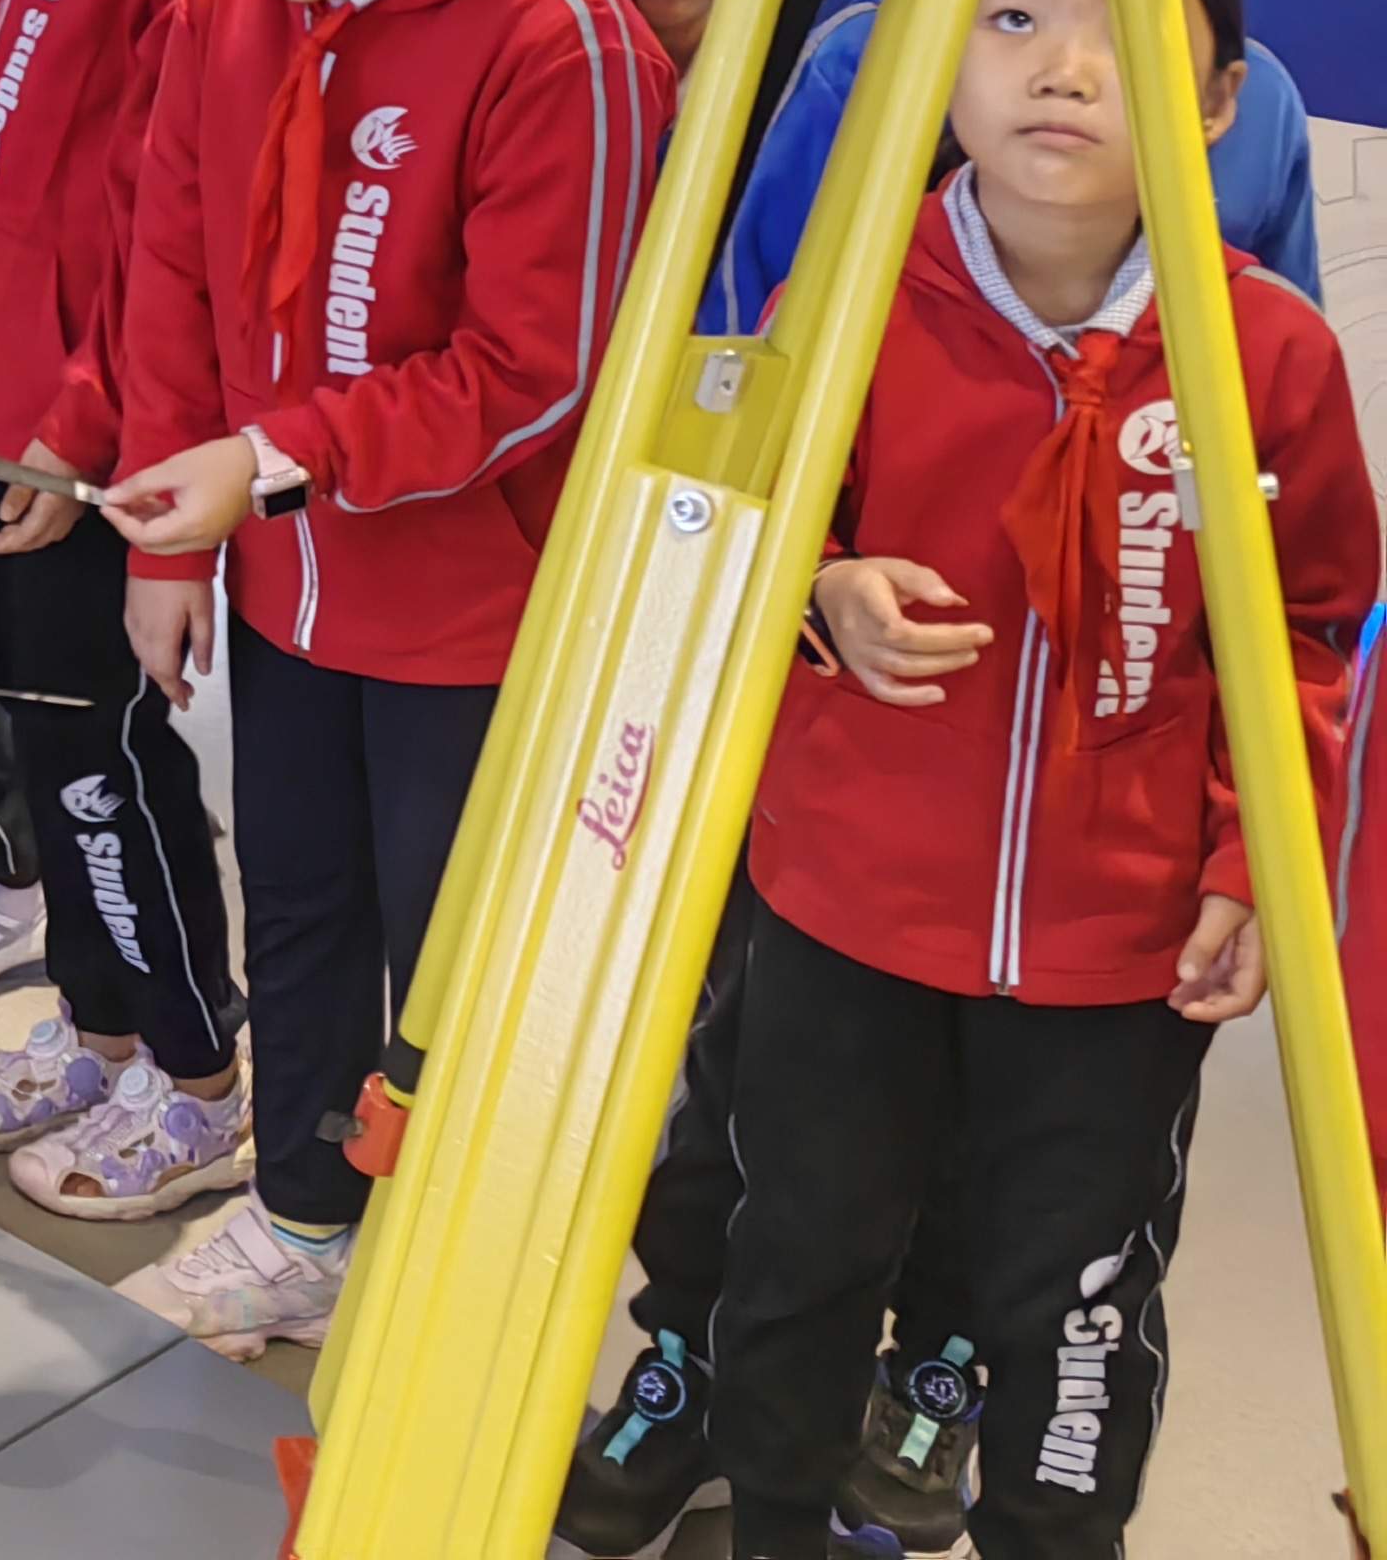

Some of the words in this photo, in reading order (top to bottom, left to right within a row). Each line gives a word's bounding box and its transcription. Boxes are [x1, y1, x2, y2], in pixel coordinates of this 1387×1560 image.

[325, 180, 391, 377] Student
[1093, 491, 1180, 719] Student
[576, 722, 655, 872] Leica
[1035, 1303, 1124, 1494] Student
